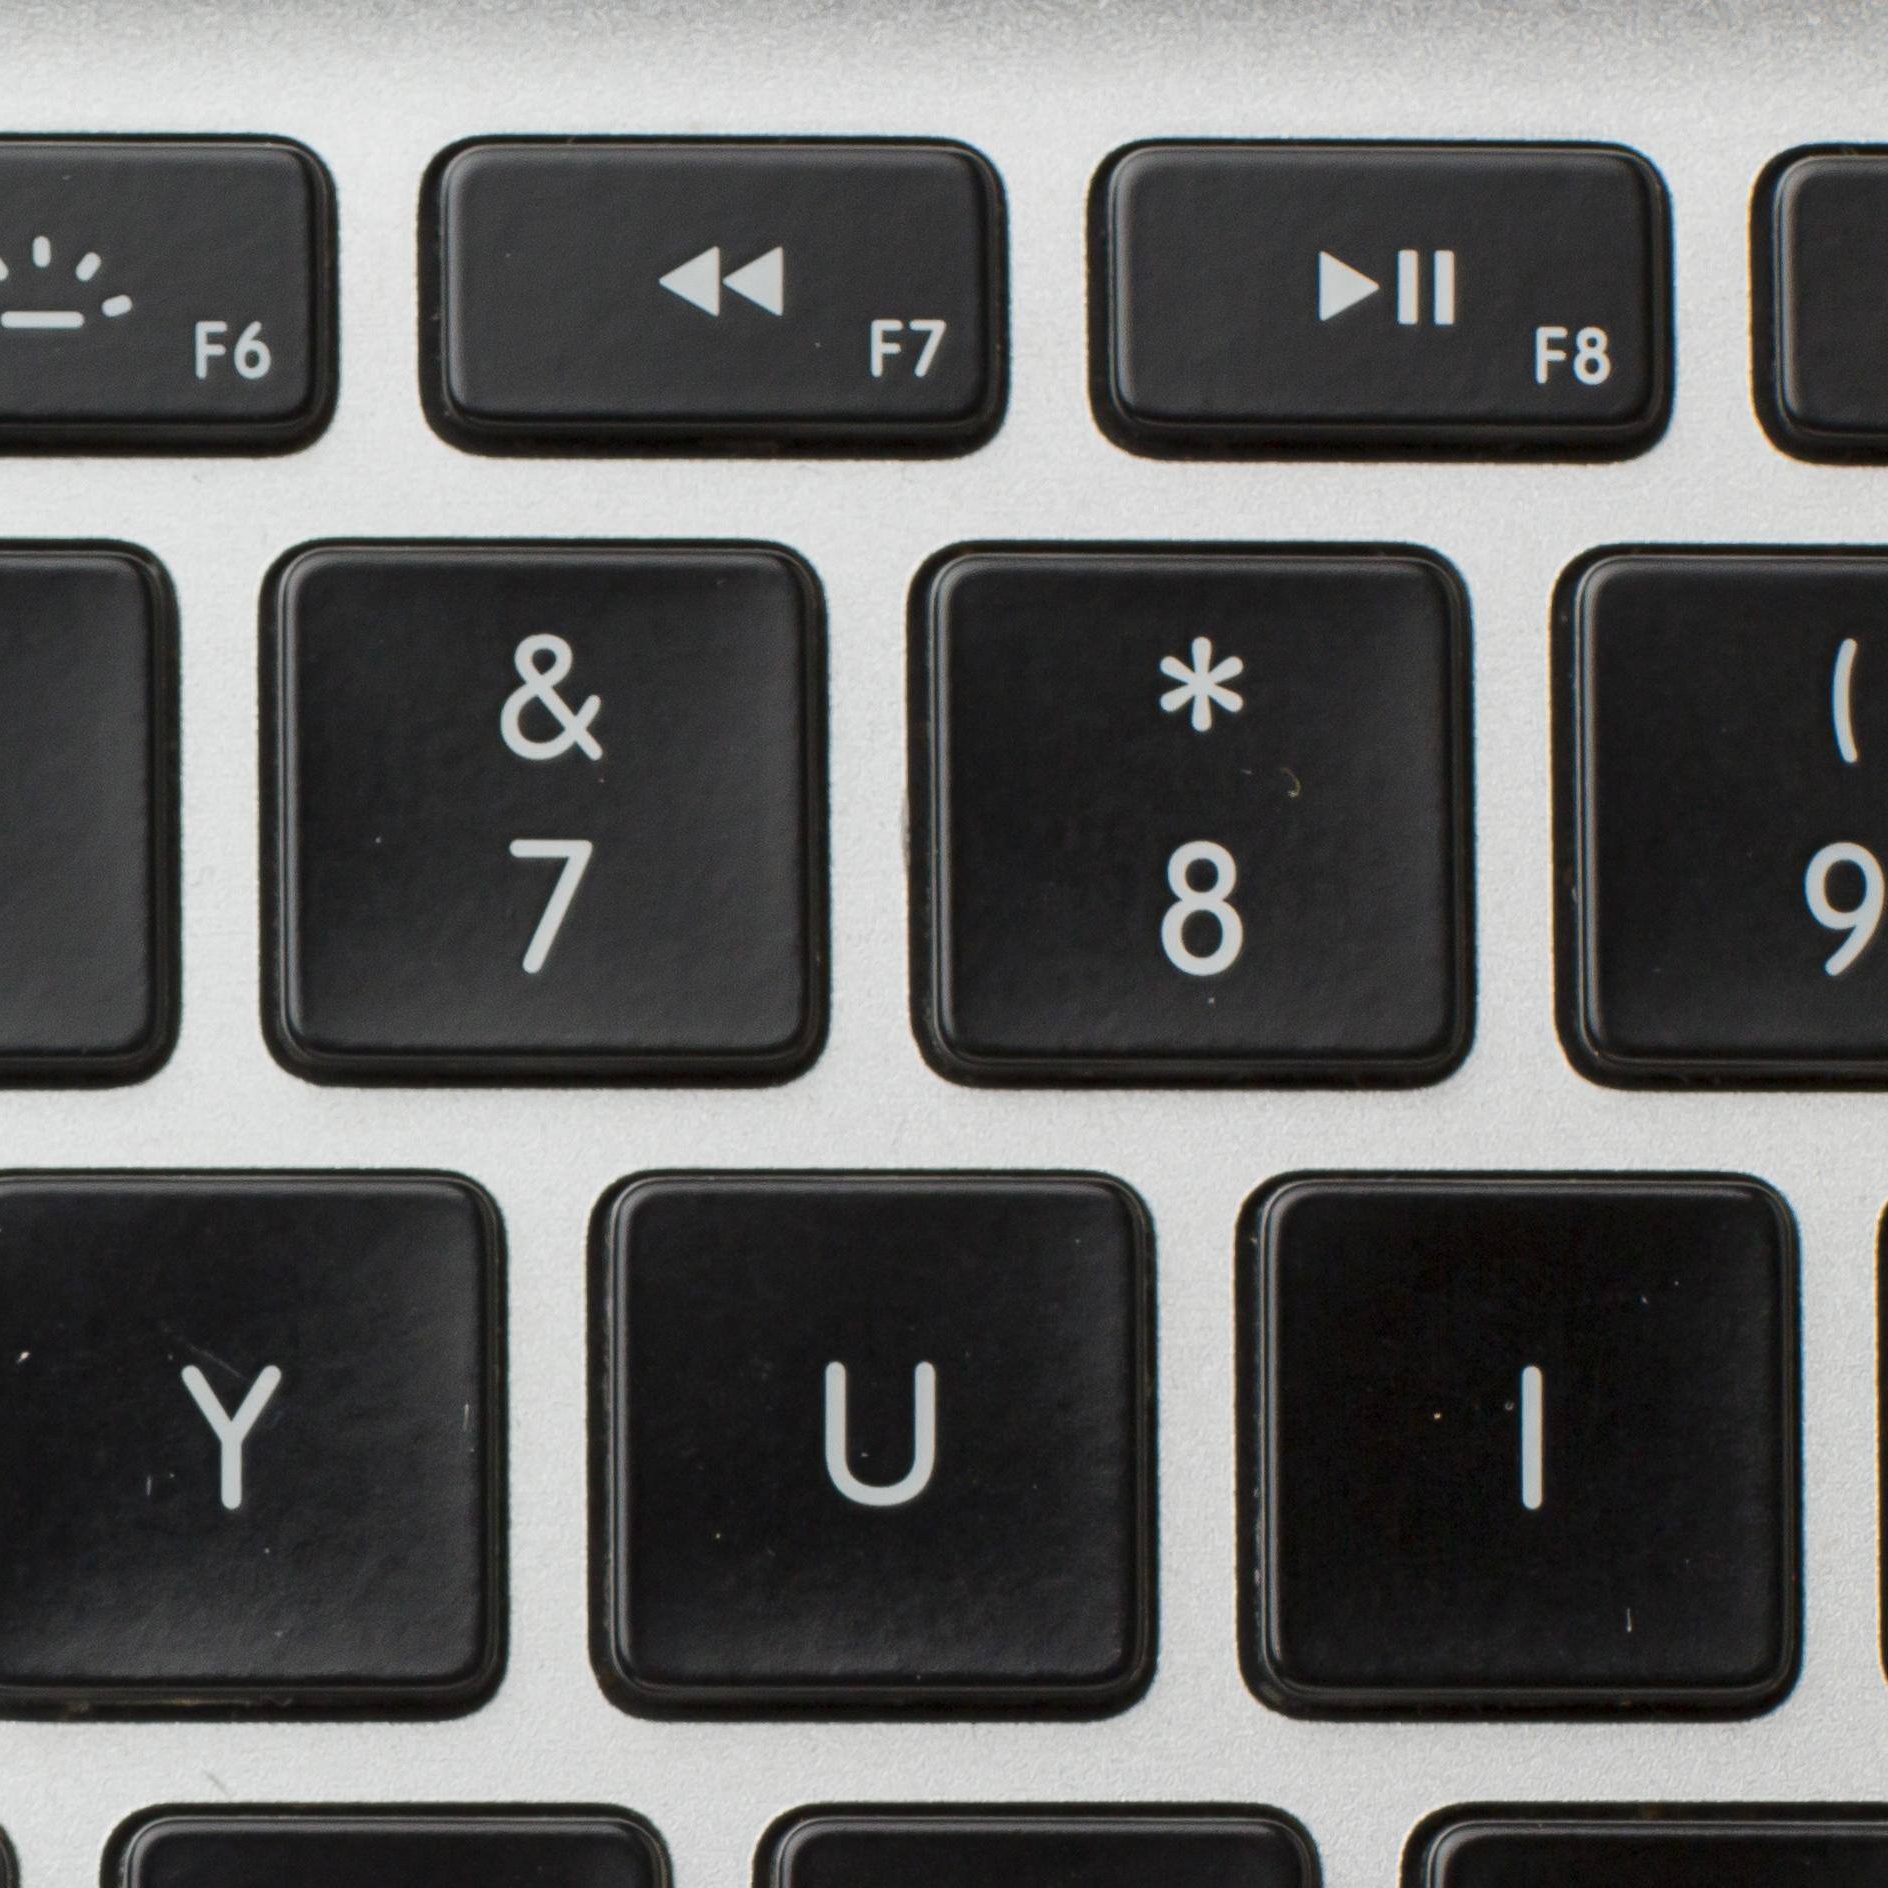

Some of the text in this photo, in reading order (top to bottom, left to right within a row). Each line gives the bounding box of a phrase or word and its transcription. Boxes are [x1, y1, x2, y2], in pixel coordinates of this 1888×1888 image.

[195, 320, 272, 380] F6
[870, 319, 947, 378] F7
[1535, 326, 1611, 386] F8
[500, 633, 604, 761] &
[1832, 638, 1859, 764] (
[509, 839, 594, 974] 7
[1161, 840, 1244, 977] 8
[1804, 841, 1886, 977] 9
[181, 1364, 282, 1511] Y
[824, 1361, 937, 1507] U
[1521, 1365, 1543, 1510] I
